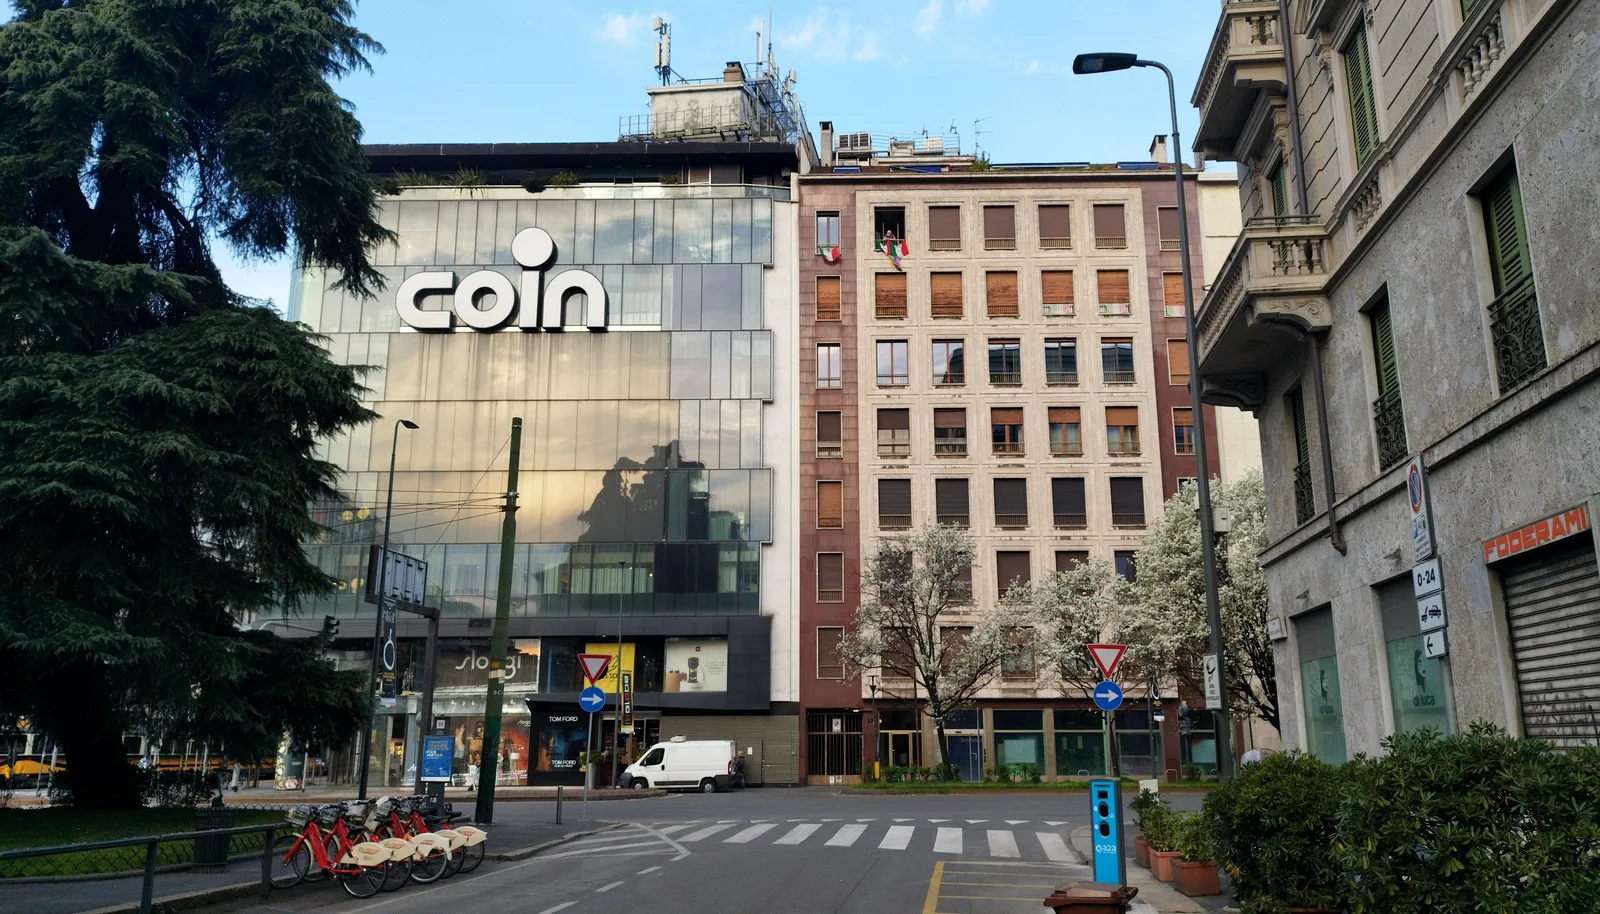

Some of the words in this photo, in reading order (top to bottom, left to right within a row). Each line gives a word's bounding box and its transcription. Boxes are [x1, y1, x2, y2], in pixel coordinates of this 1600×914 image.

[396, 227, 609, 332] coin
[1483, 506, 1588, 562] FODERAMI
[1417, 568, 1436, 587] 0-24
[455, 649, 521, 680] slogi
